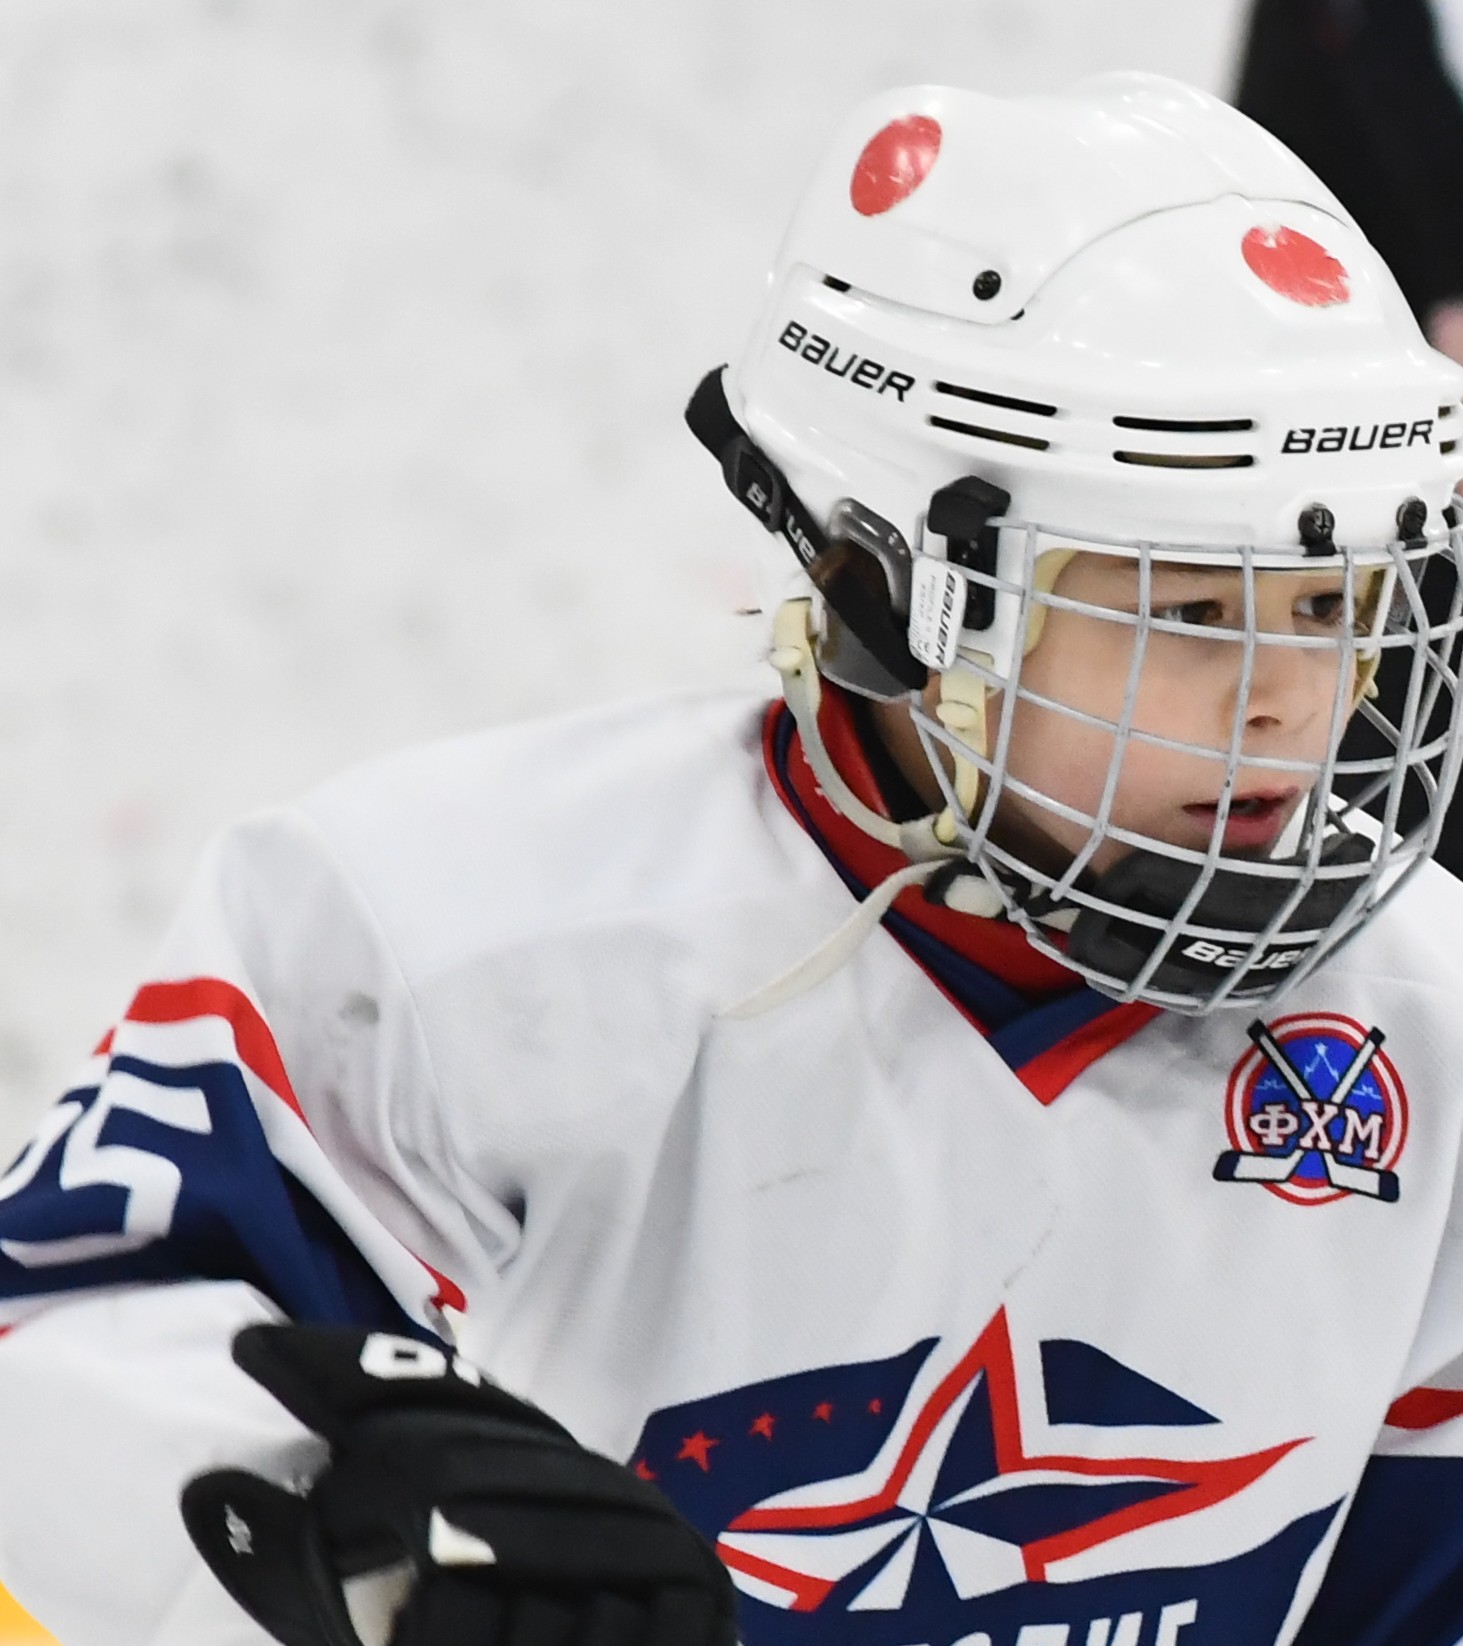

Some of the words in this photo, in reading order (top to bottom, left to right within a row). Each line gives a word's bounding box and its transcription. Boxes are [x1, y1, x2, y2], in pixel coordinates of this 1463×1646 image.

[777, 319, 916, 403] BAUER
[1280, 418, 1435, 455] BAUER
[1182, 940, 1304, 970] BAUE
[1249, 1102, 1384, 1161] ФХМ
